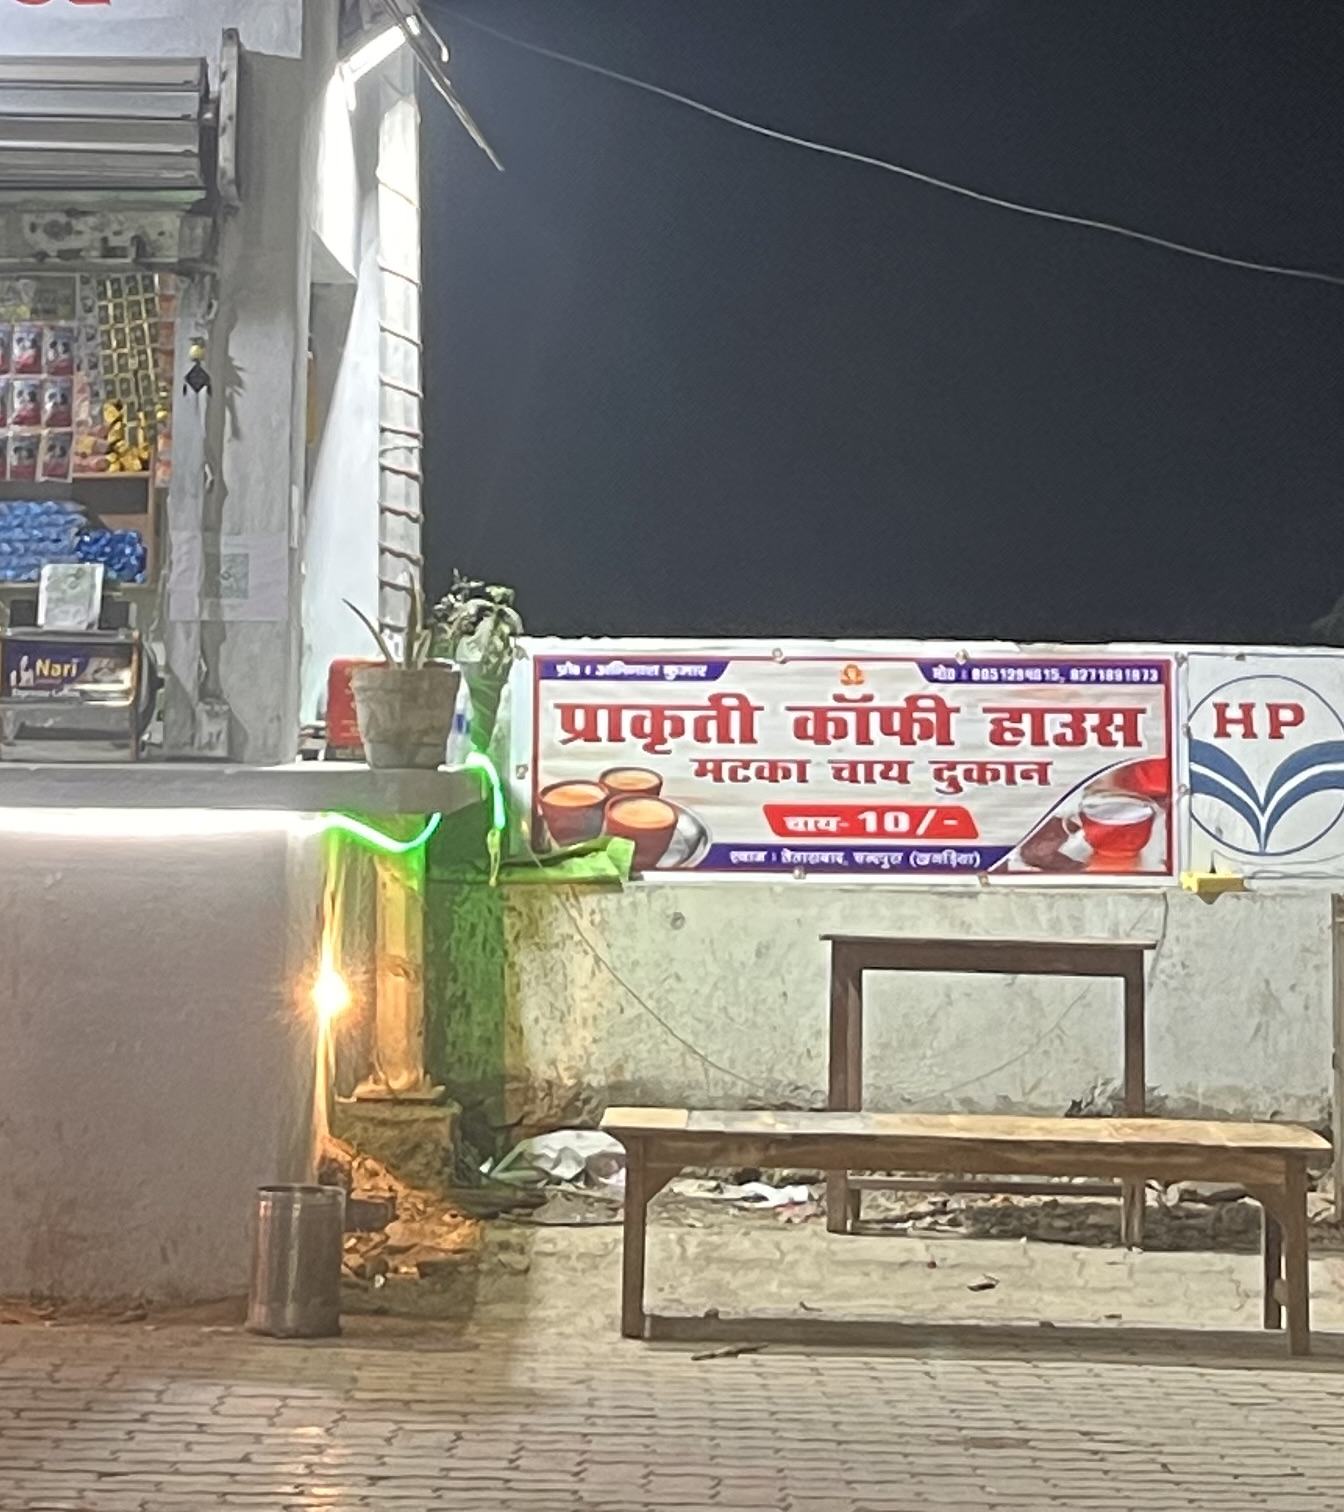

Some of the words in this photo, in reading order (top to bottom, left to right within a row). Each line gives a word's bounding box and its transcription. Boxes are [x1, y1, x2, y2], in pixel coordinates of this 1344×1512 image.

[553, 693, 764, 754] प्राकृती
[786, 693, 960, 747] कॉफी
[983, 705, 1146, 747] हाउस
[1212, 702, 1306, 739] HP
[690, 758, 811, 783] मटका
[828, 758, 912, 784] चाय
[928, 759, 1053, 793] दुकान
